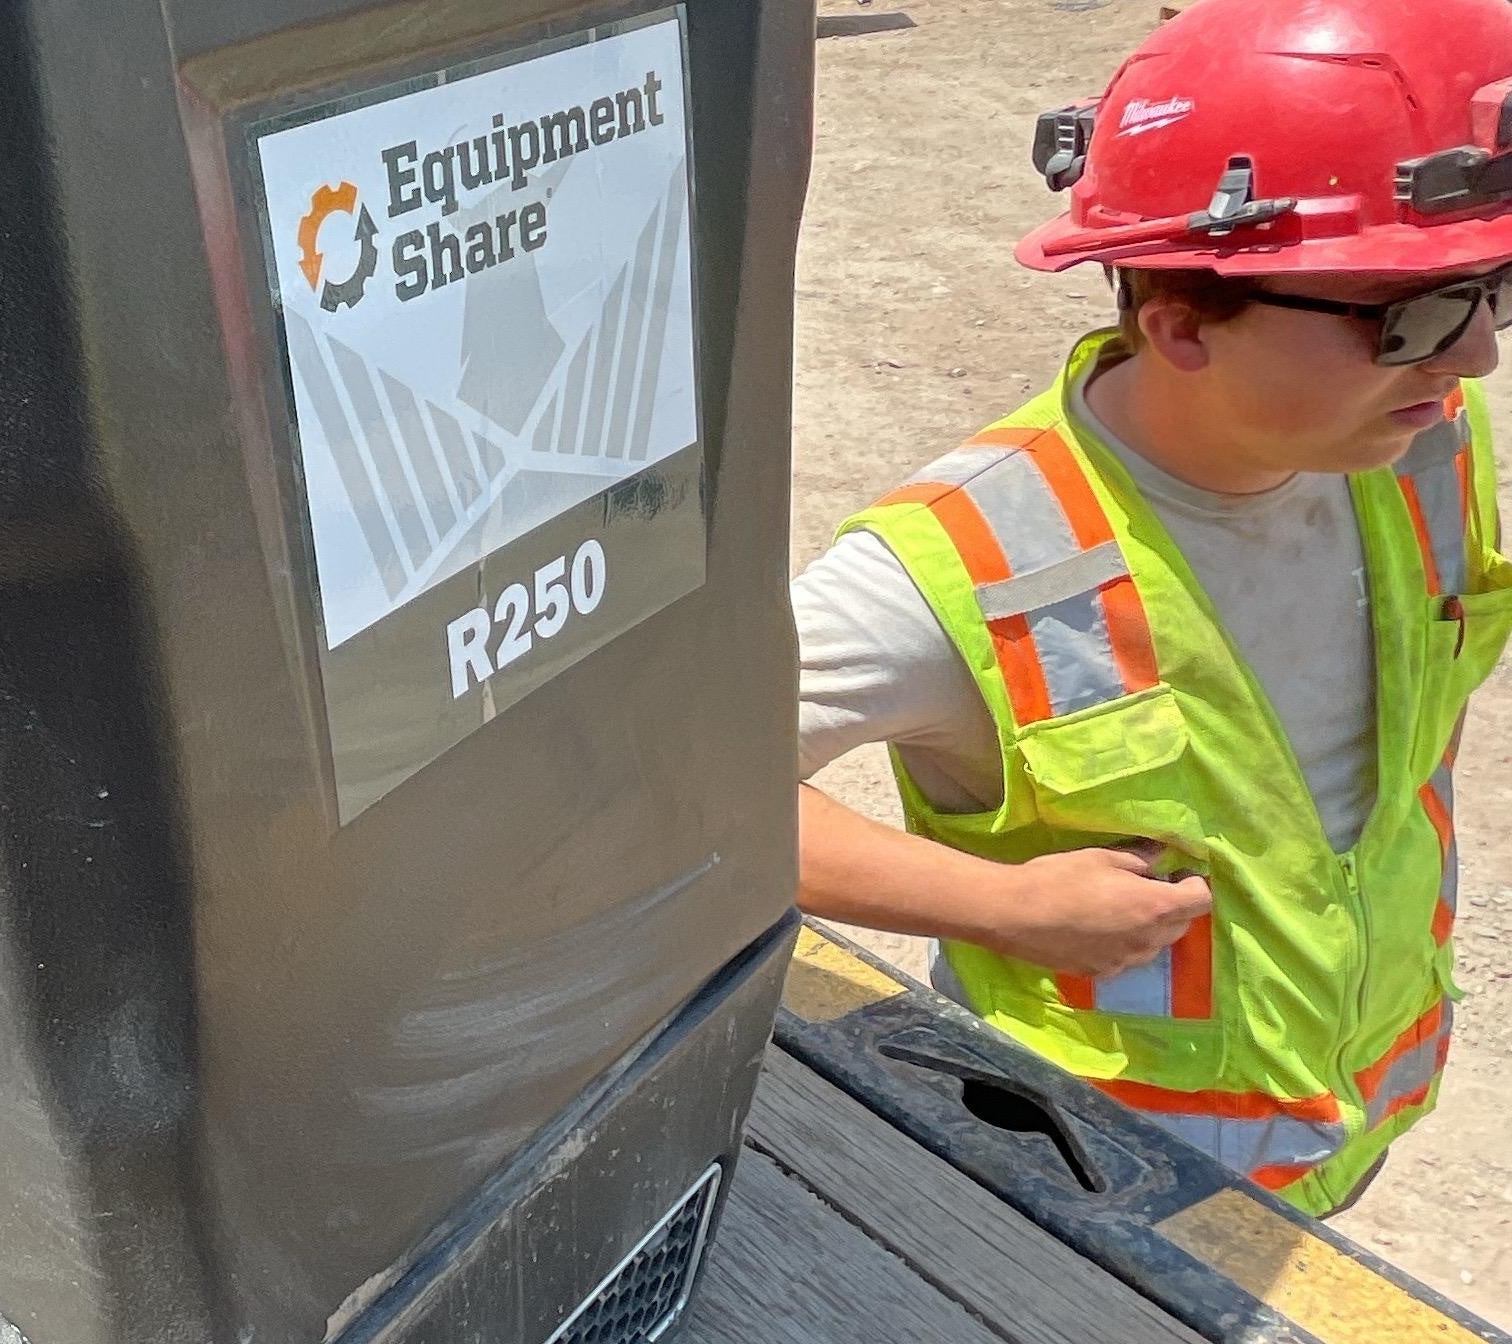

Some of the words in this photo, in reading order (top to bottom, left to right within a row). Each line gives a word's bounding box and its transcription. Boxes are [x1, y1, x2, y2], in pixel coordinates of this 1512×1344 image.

[380, 70, 665, 219] Equipment
[1119, 96, 1193, 129] Milwaukee
[391, 200, 549, 304] Share
[446, 538, 606, 700] R250
